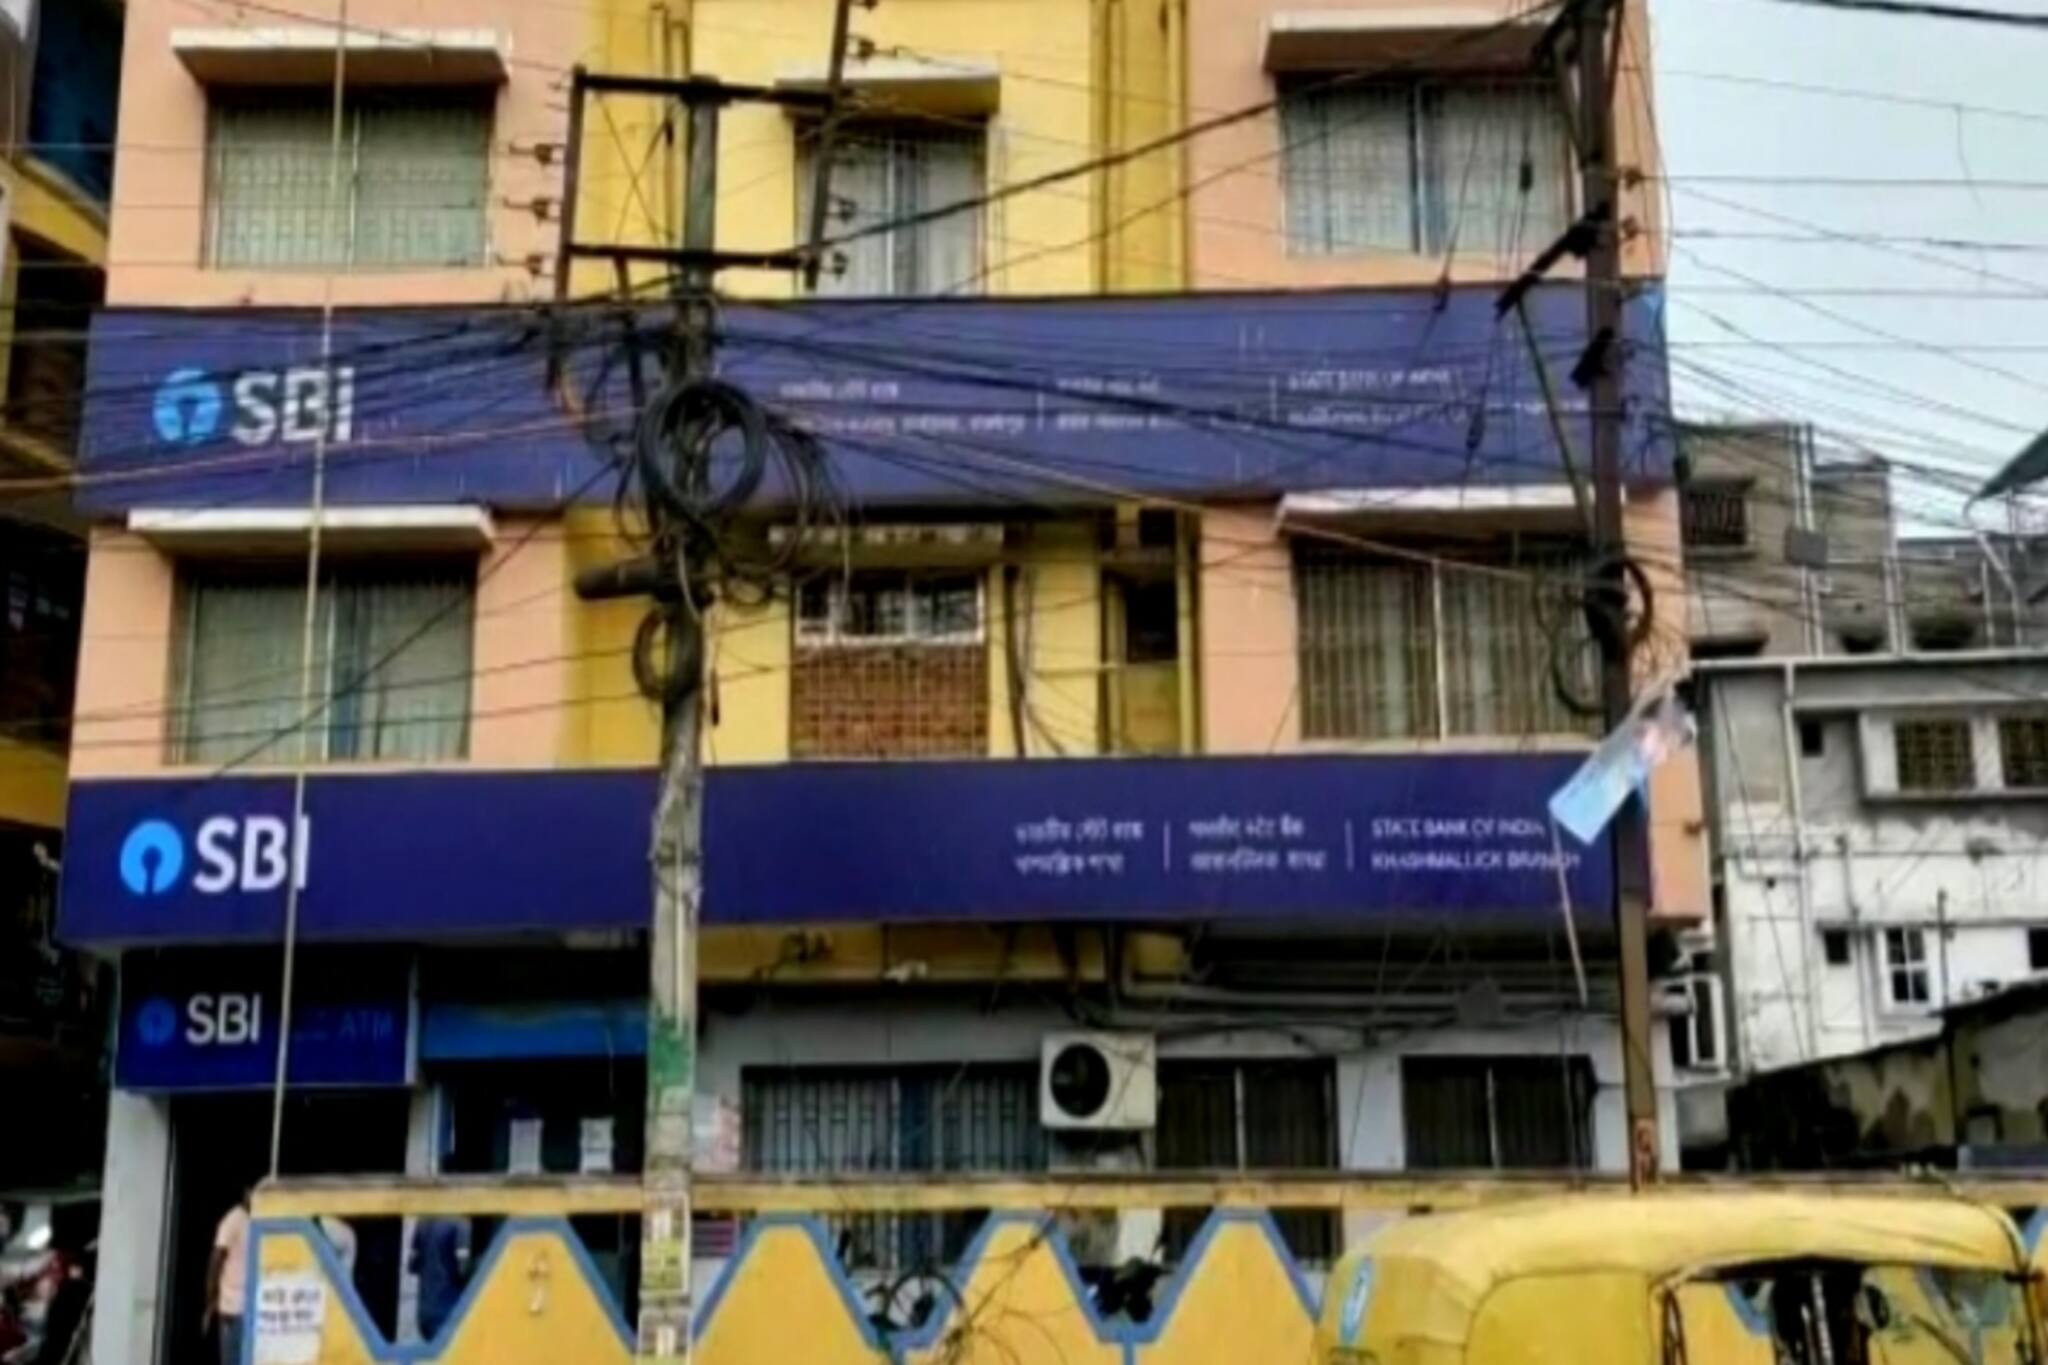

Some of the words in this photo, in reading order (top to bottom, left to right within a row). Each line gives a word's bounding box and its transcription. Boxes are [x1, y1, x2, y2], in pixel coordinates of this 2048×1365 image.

[231, 366, 355, 446] SBI
[193, 814, 310, 893] SBI
[185, 993, 262, 1045] SBI
